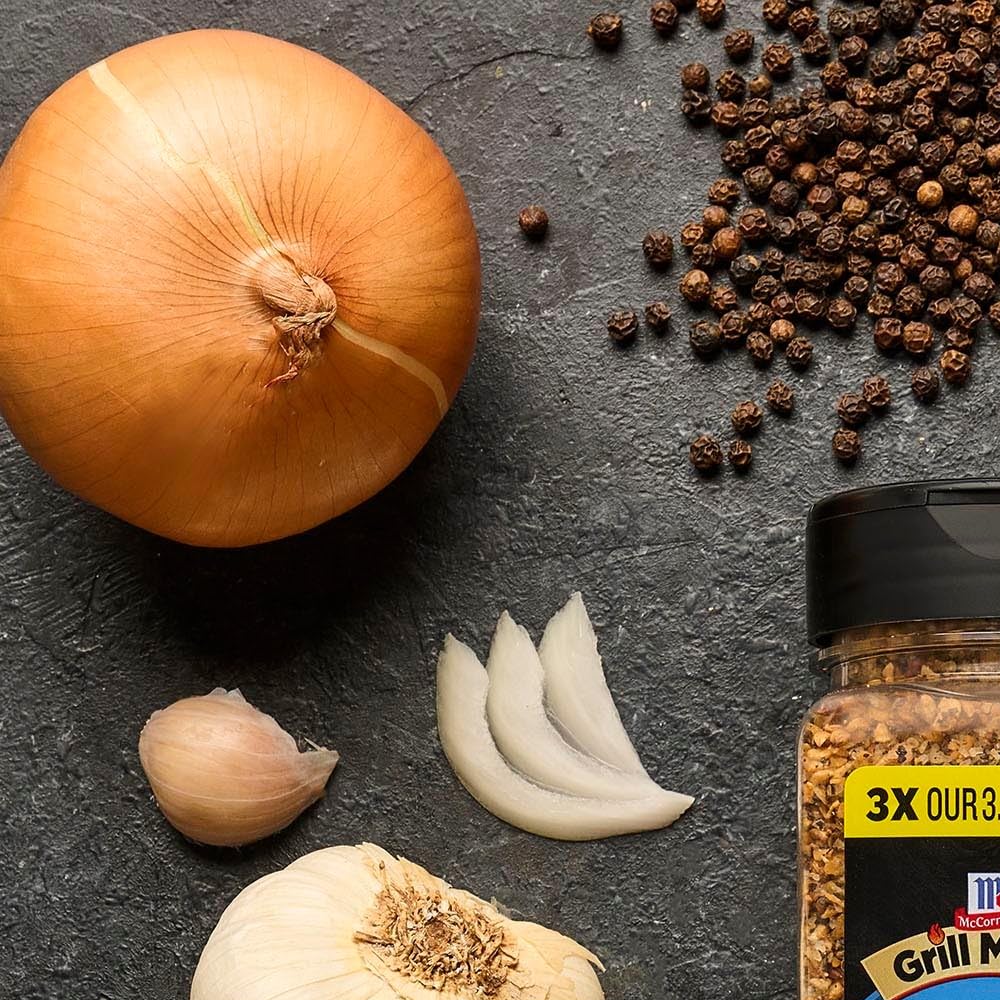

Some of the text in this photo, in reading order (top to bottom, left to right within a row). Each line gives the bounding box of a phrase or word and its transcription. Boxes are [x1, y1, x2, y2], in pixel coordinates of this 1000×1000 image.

[866, 787, 920, 822] 3X
[927, 787, 978, 821] OUR
[893, 931, 971, 983] Grill
